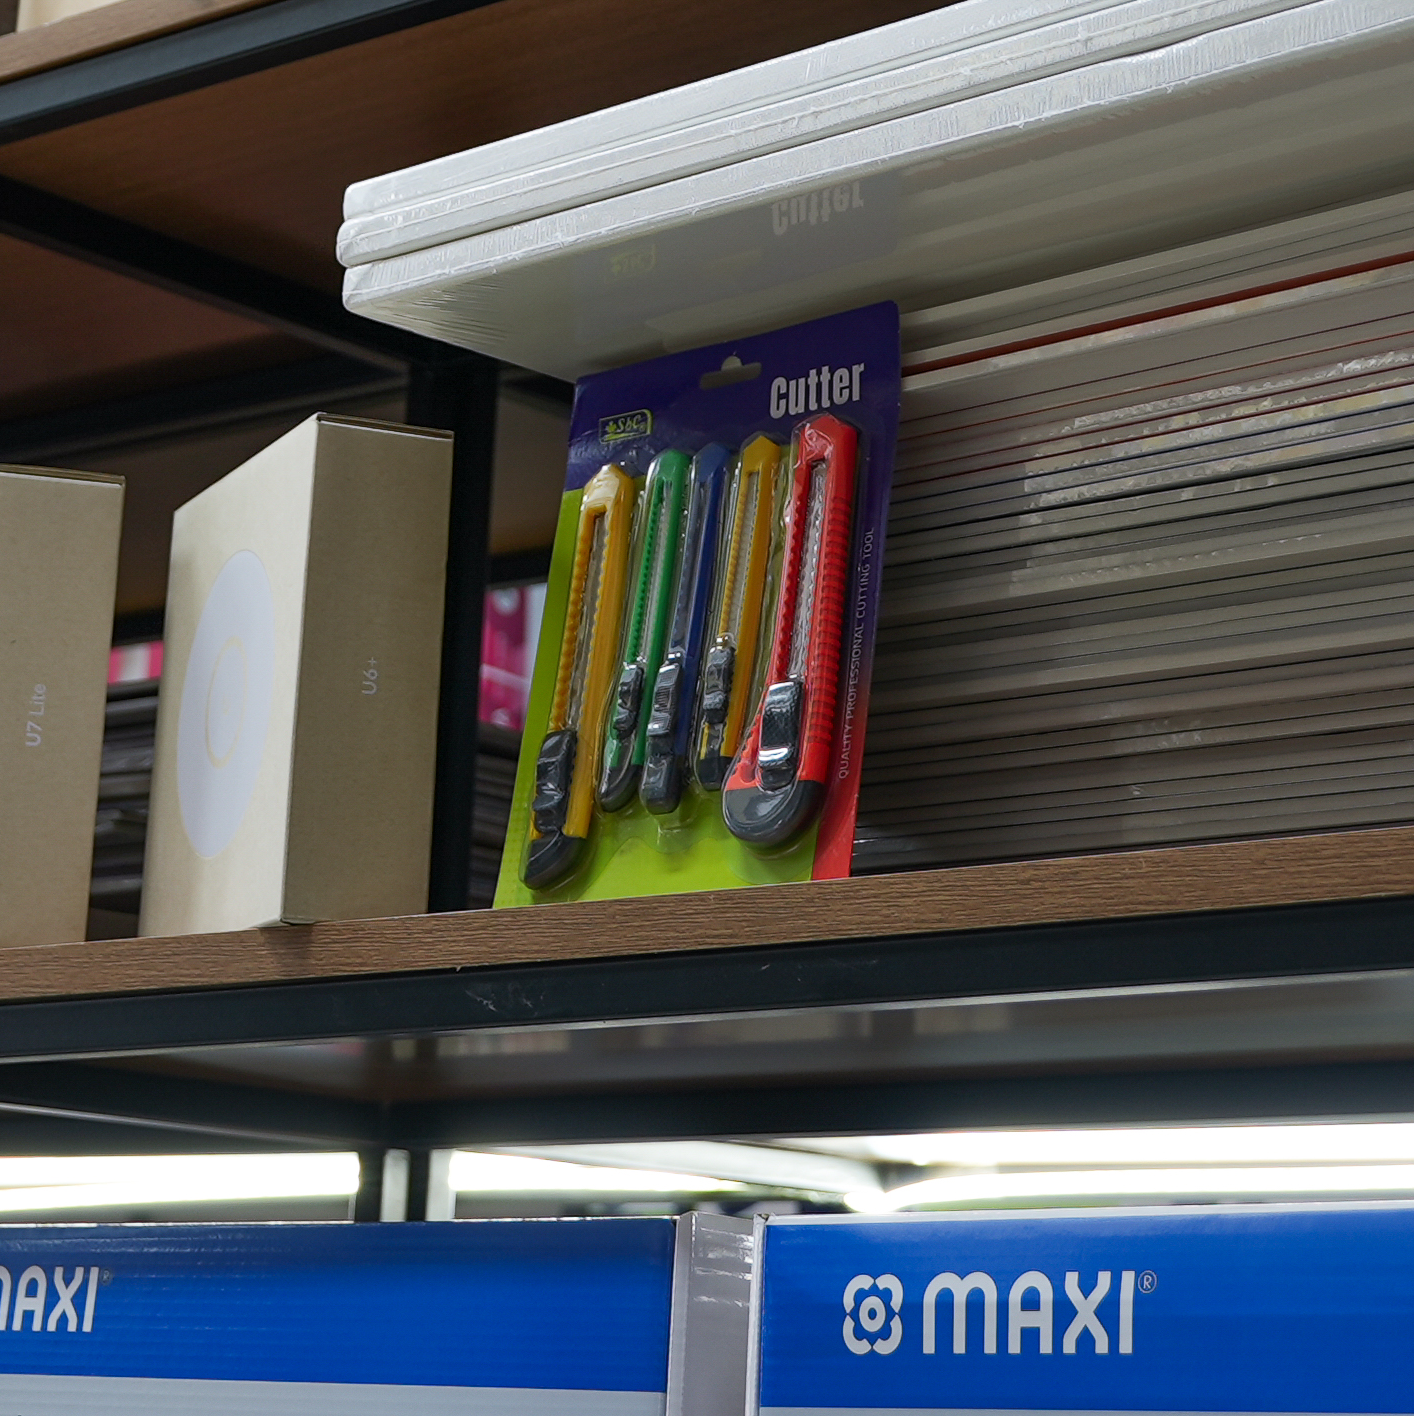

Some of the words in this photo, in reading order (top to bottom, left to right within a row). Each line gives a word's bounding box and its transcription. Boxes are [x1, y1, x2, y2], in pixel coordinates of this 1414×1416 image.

[769, 360, 866, 420] Cutter
[862, 526, 876, 560] TOOL
[855, 563, 871, 620] CUTTING
[361, 656, 378, 695] U6+
[846, 620, 865, 720] PROFESSIONAL
[30, 683, 47, 717] Lite
[25, 721, 44, 748] U7
[838, 724, 851, 780] QUALITY
[922, 1269, 1136, 1355] MAXI
